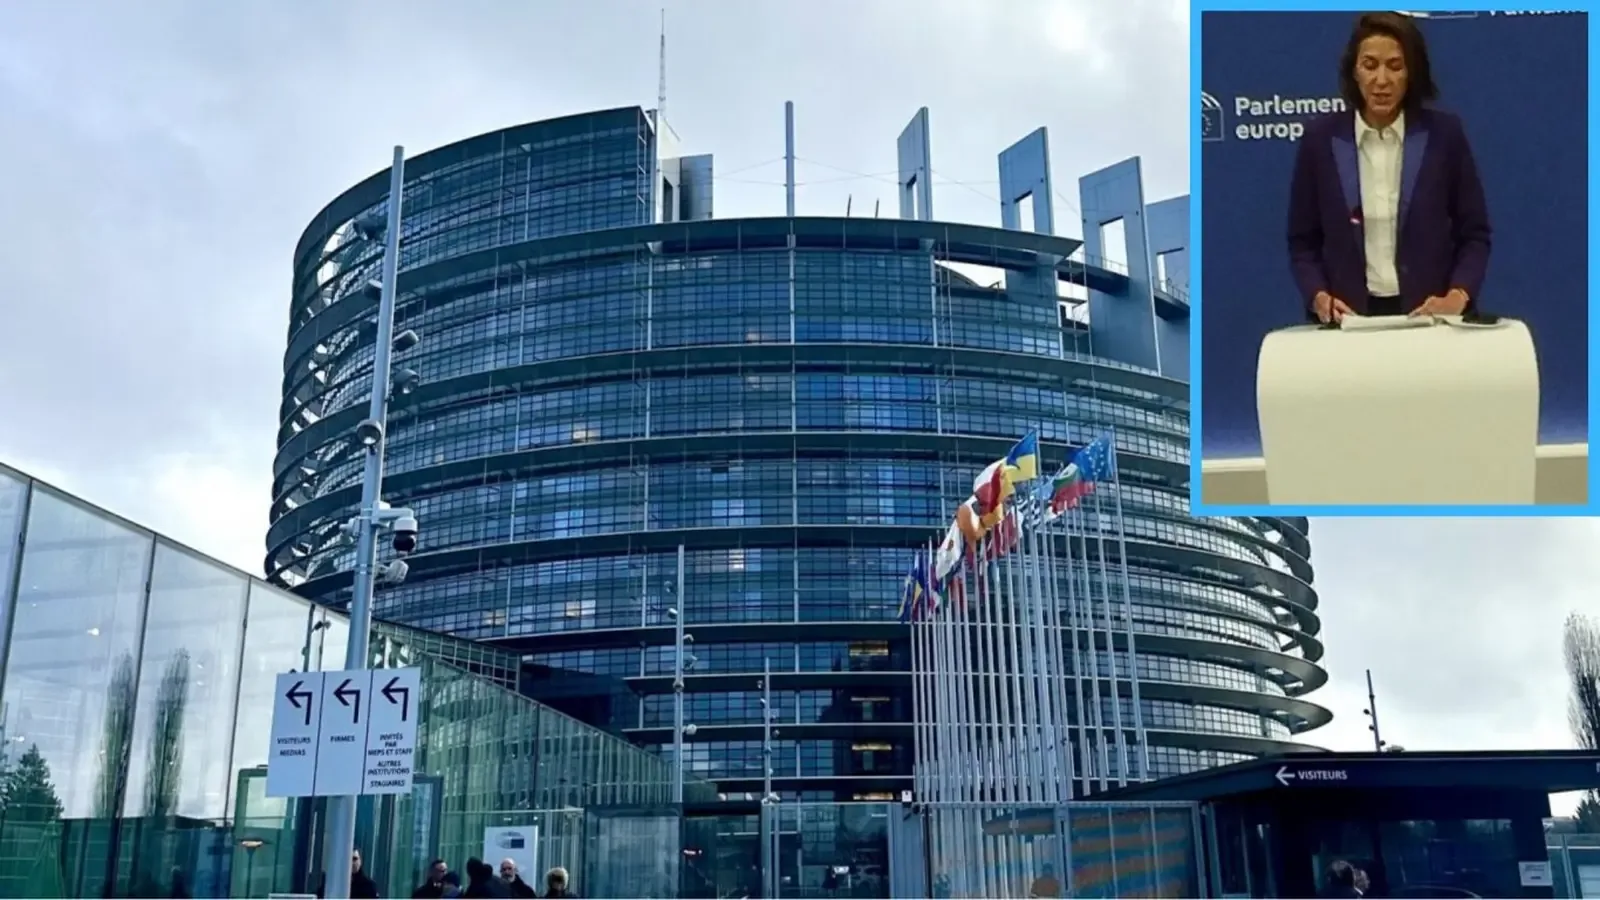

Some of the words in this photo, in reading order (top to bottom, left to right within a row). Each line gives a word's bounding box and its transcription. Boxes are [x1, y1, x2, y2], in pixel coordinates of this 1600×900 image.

[1234, 94, 1346, 116] Parlemen
[1235, 122, 1304, 141] europ
[1298, 770, 1348, 780] VISITEURS
